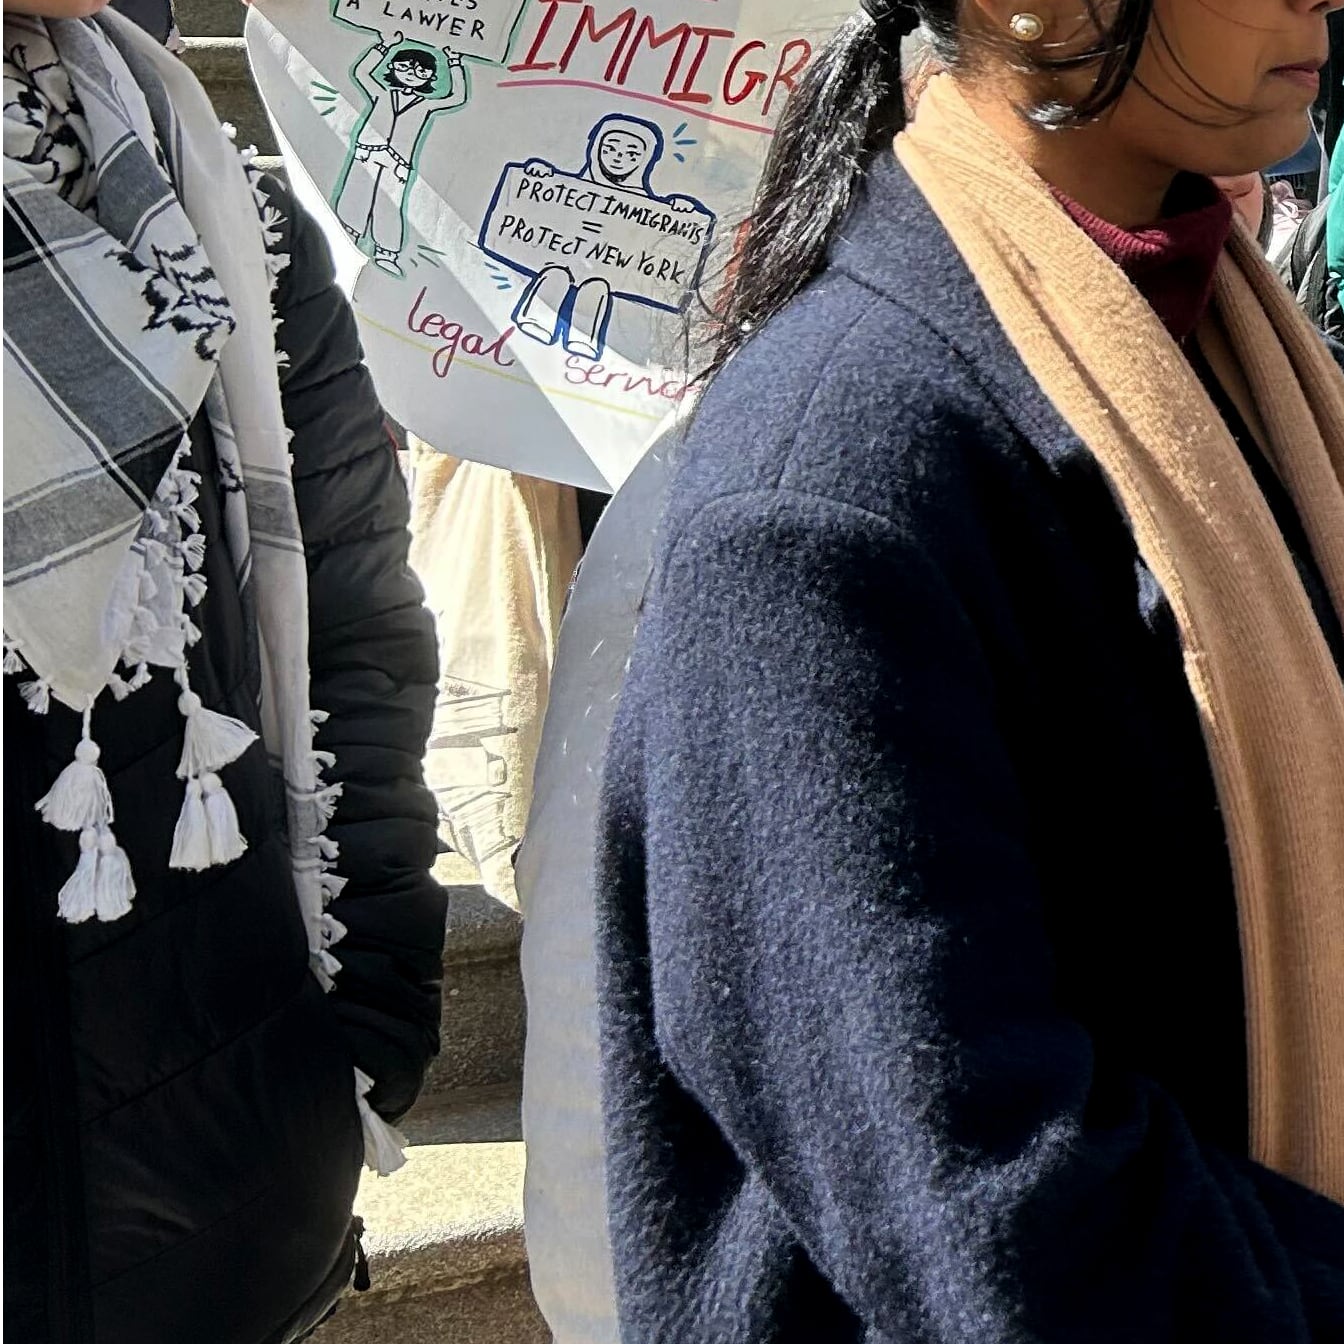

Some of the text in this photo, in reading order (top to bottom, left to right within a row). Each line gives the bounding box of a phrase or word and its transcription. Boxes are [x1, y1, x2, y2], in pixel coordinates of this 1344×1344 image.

[383, 0, 486, 41] LAWYER
[516, 177, 705, 246] PROTECT IMMIGRANTS
[498, 214, 686, 285] PROTECT NEW YORK
[407, 285, 516, 378] legal
